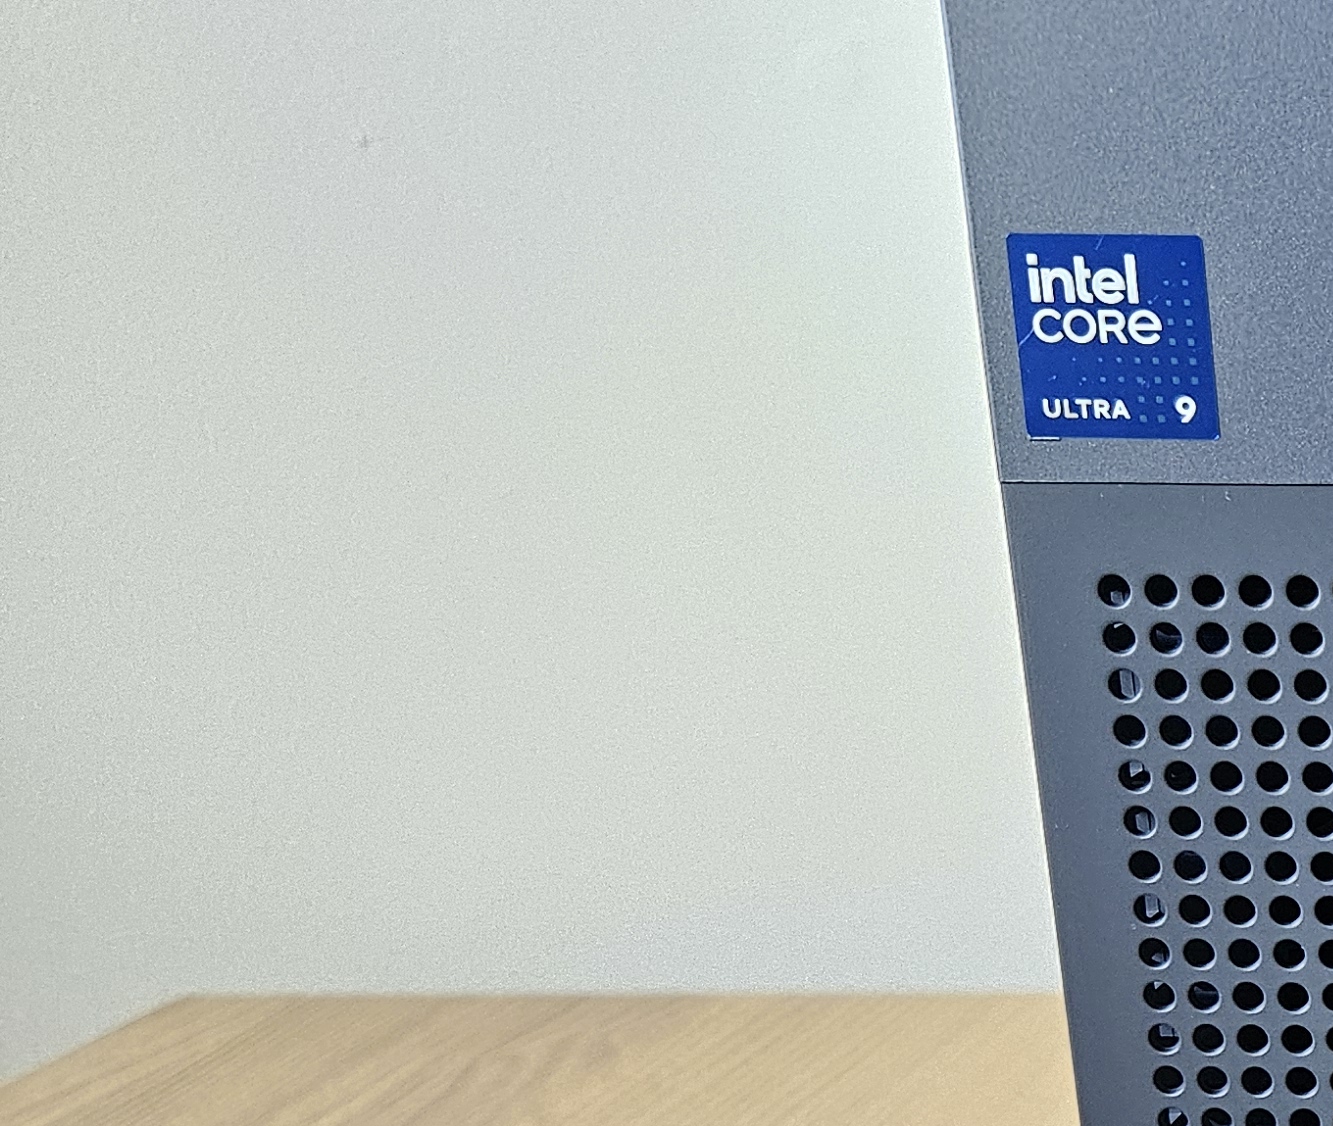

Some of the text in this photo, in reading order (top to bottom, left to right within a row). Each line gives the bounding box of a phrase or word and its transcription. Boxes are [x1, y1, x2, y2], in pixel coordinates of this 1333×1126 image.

[1026, 253, 1139, 304] intel
[1041, 395, 1197, 424] ULTRA 9
